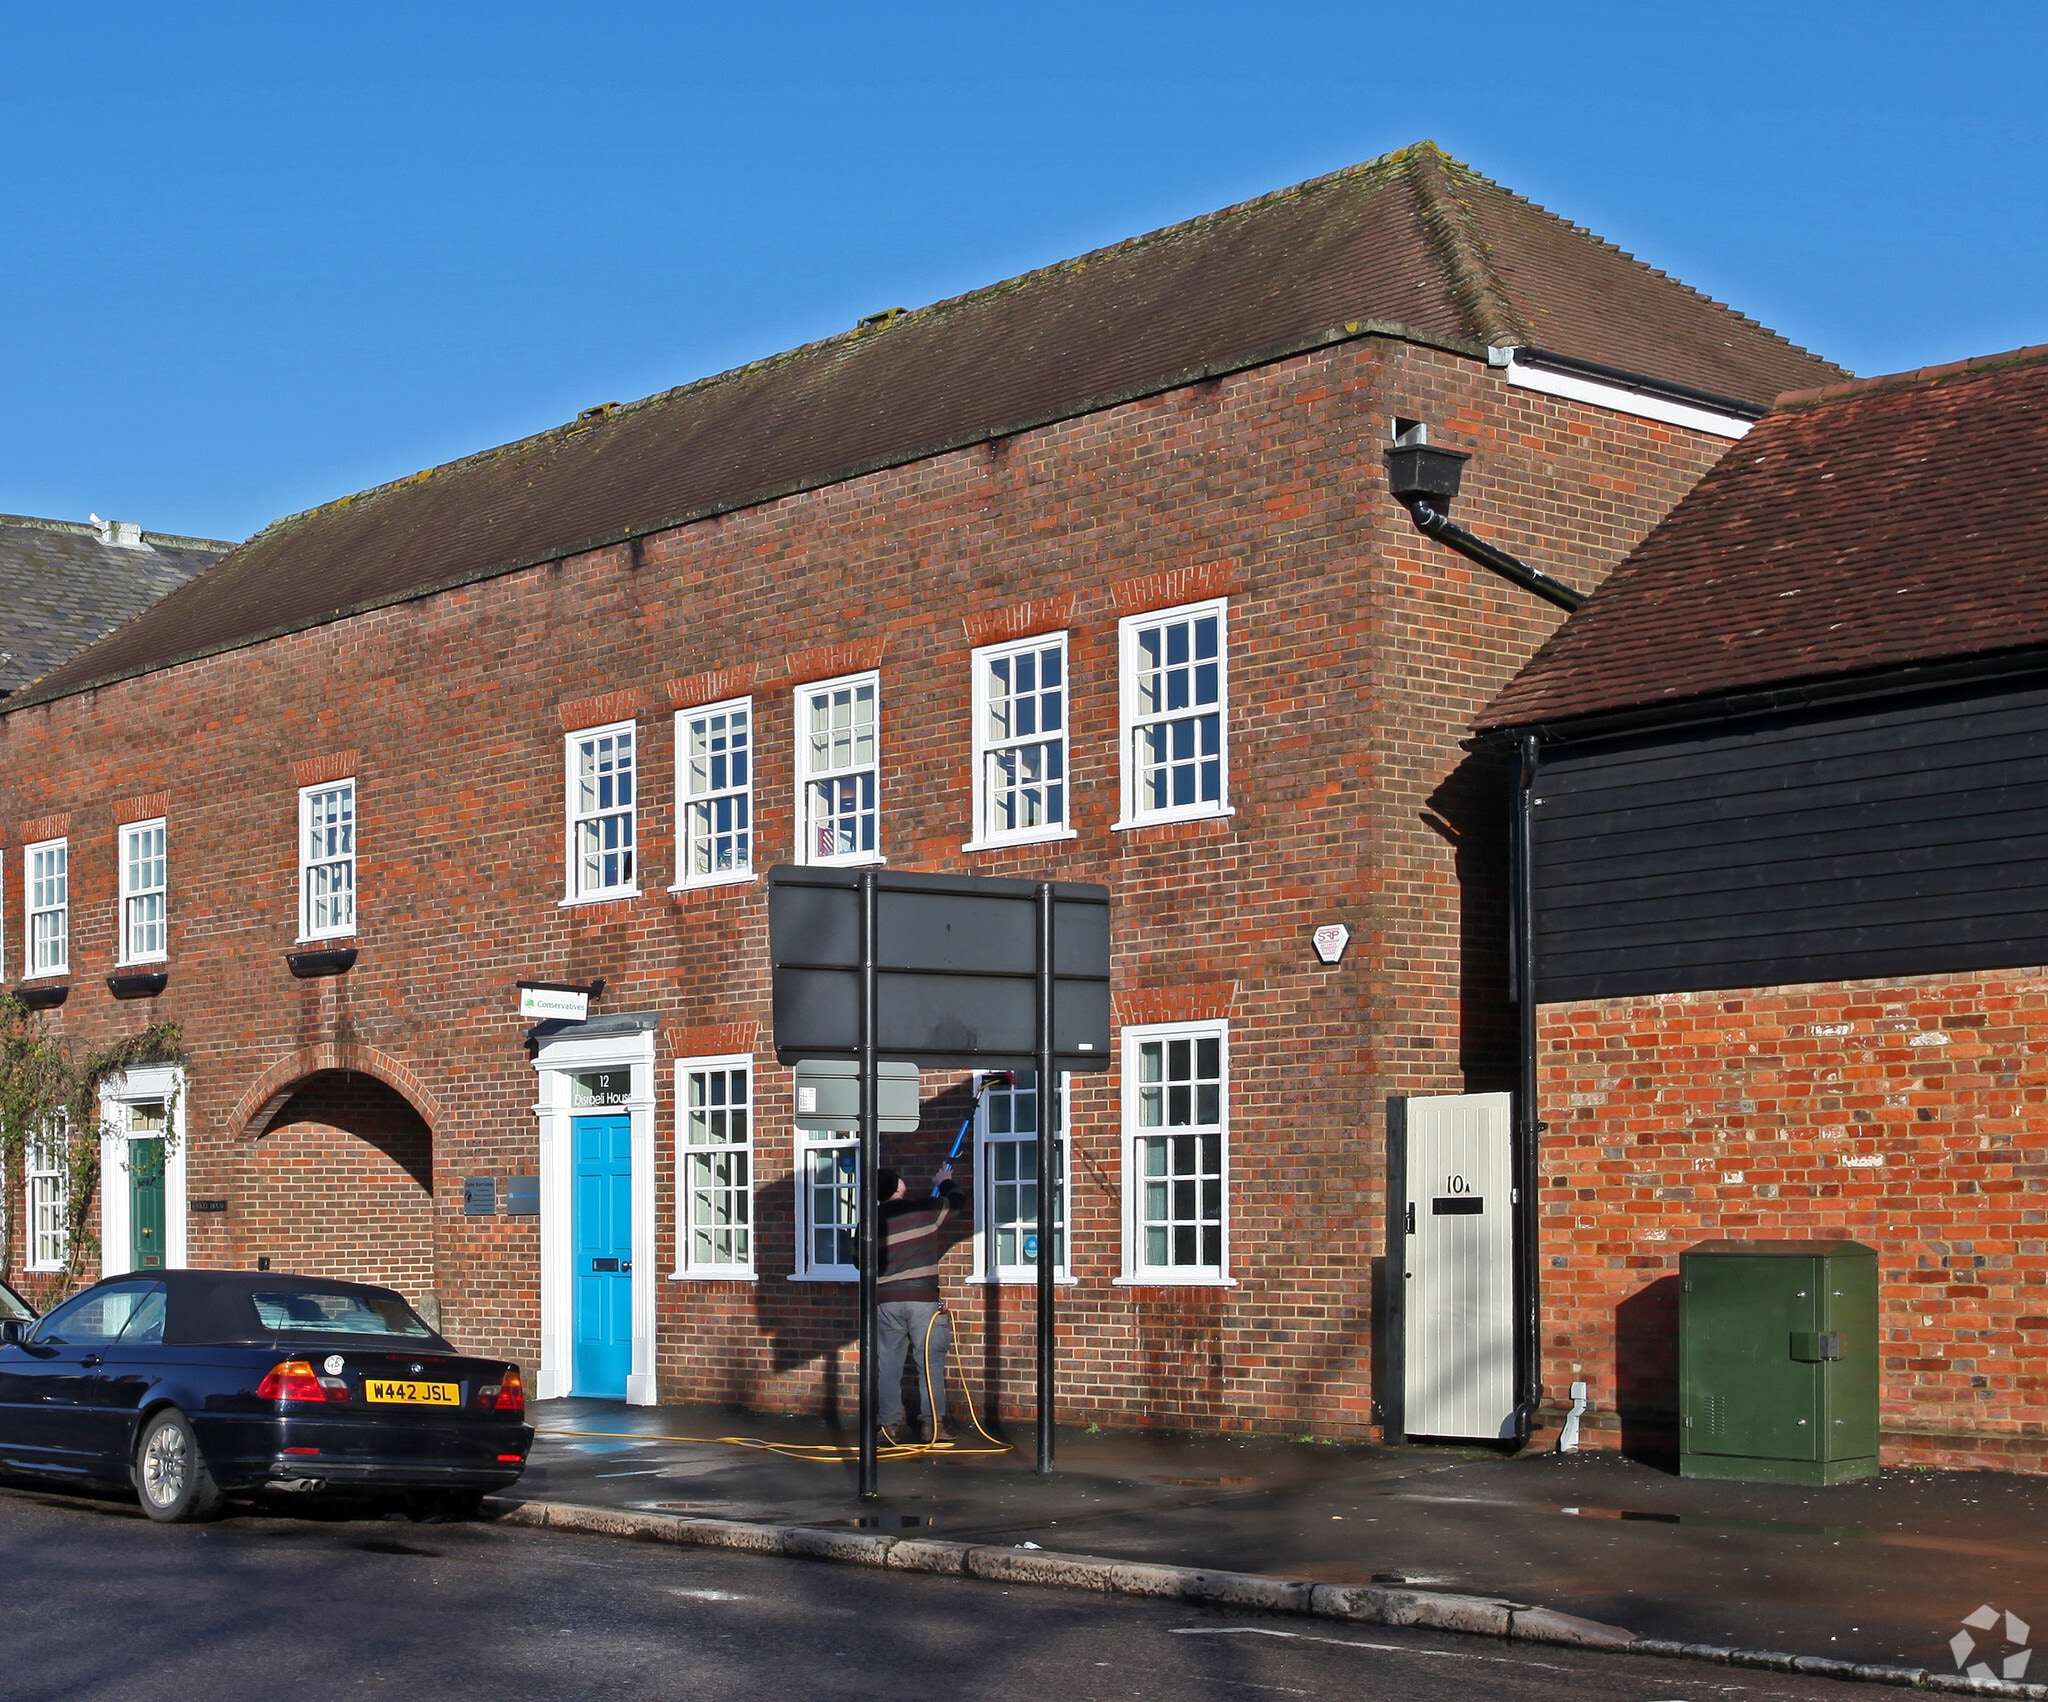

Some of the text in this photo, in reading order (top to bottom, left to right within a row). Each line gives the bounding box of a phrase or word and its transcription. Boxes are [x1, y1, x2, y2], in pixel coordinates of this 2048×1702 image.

[1317, 930, 1340, 942] SRP
[537, 999, 585, 1011] Conservatives
[599, 1074, 610, 1088] 12
[574, 1092, 605, 1106] Disraeli
[327, 1357, 342, 1369] GB
[374, 1383, 452, 1401] W442 JSL
